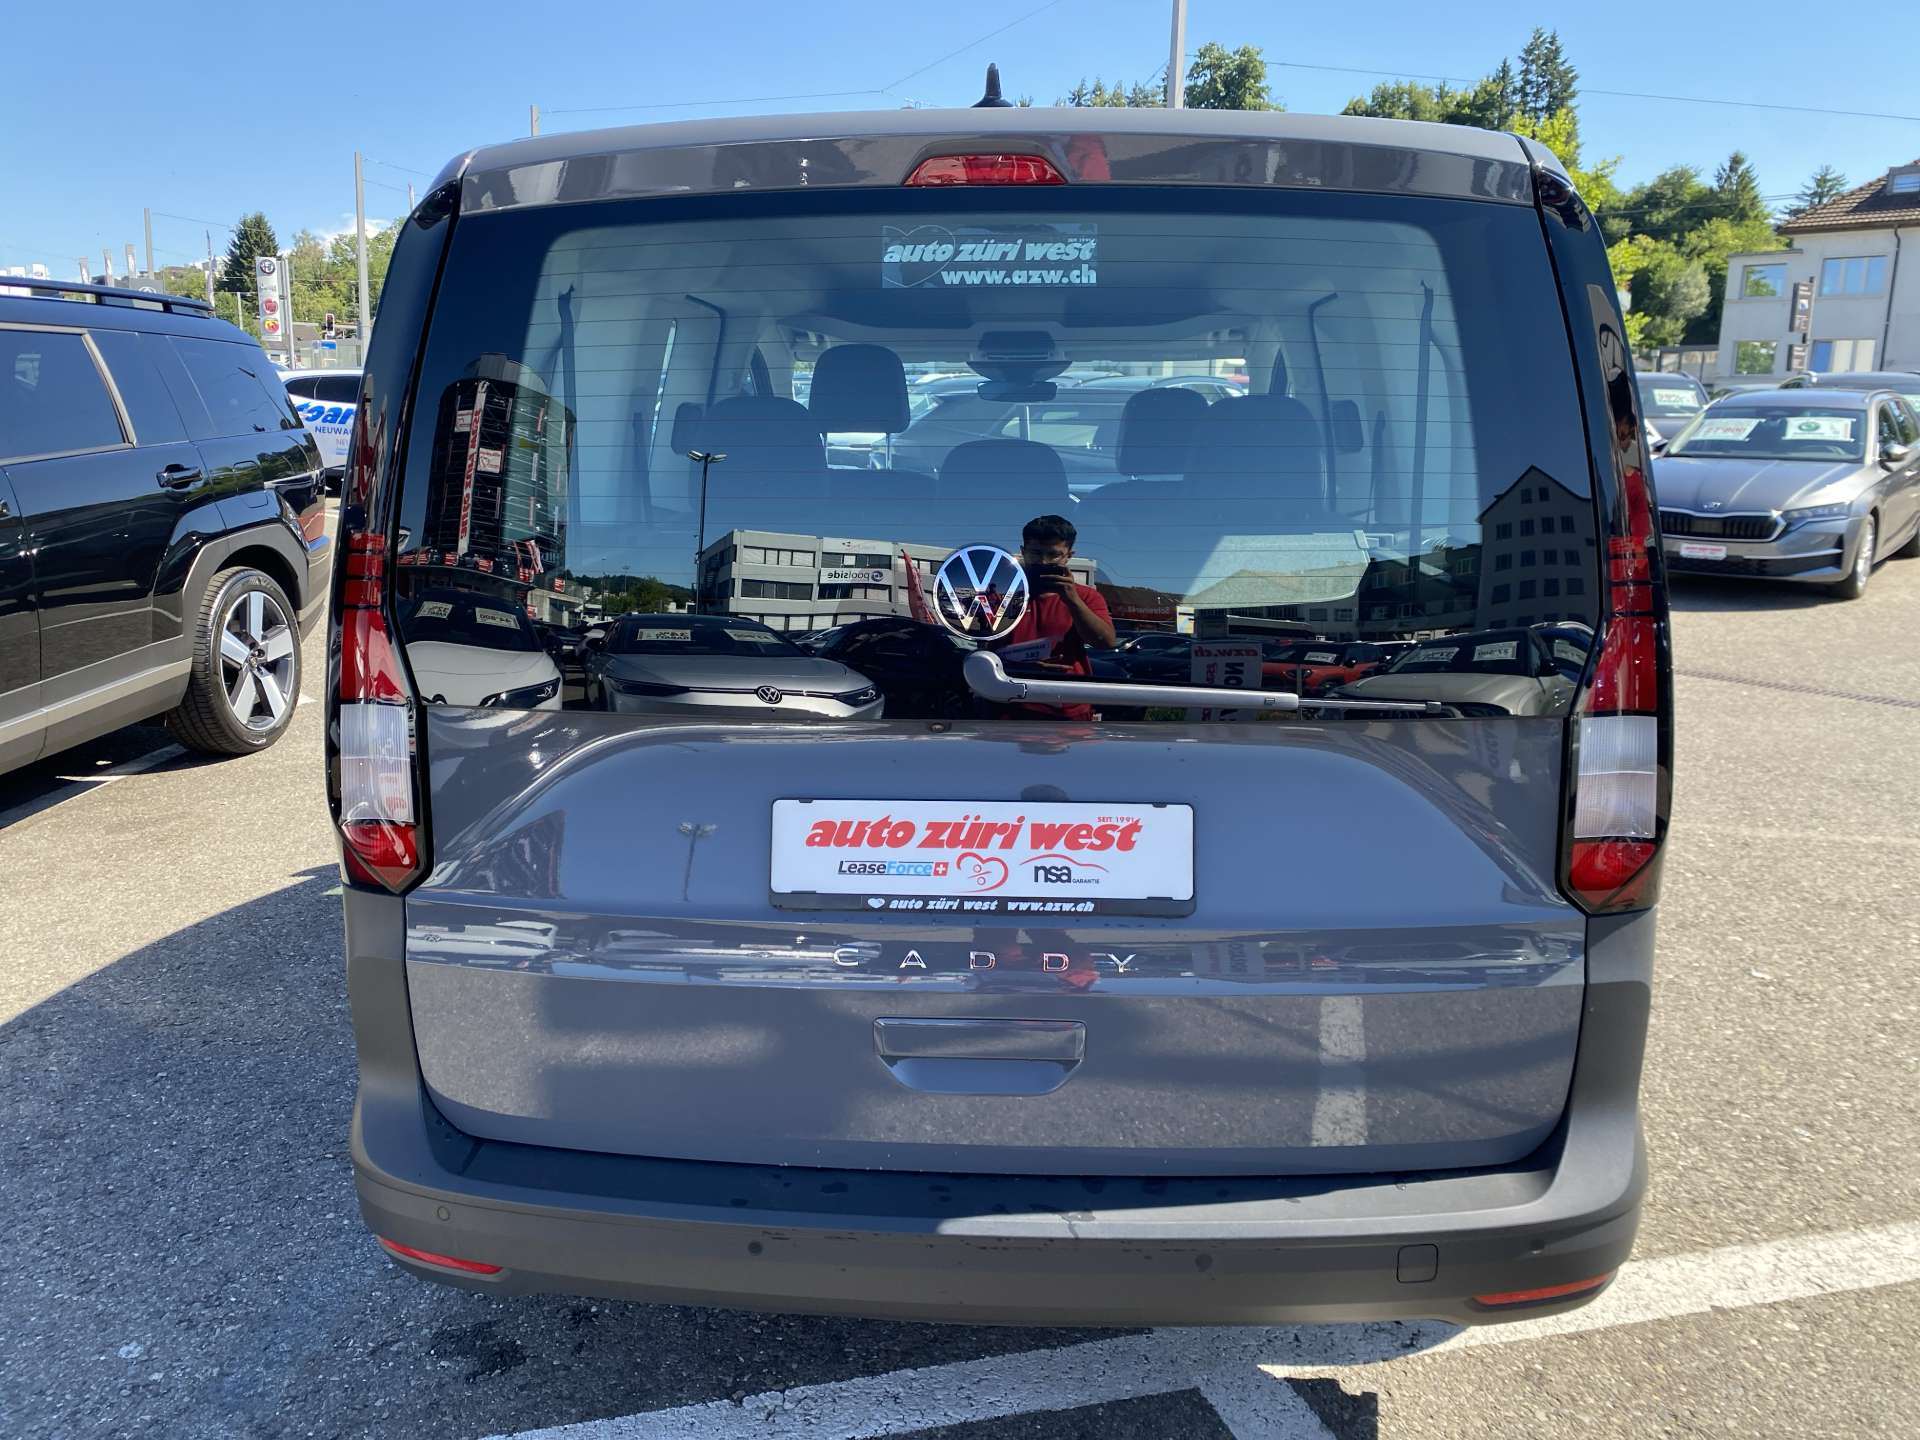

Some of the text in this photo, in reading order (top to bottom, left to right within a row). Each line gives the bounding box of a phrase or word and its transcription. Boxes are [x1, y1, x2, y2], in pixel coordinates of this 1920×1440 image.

[883, 238, 1097, 263] auto züri west
[941, 263, 1097, 285] www.azw.ch
[315, 421, 353, 436] NEUWA
[805, 815, 1144, 851] auto züri west
[838, 860, 933, 875] LeaseForce
[1034, 865, 1072, 884] nsa
[889, 898, 1095, 912] auto züri west www.azw.ch
[832, 948, 1137, 973] CADDY
